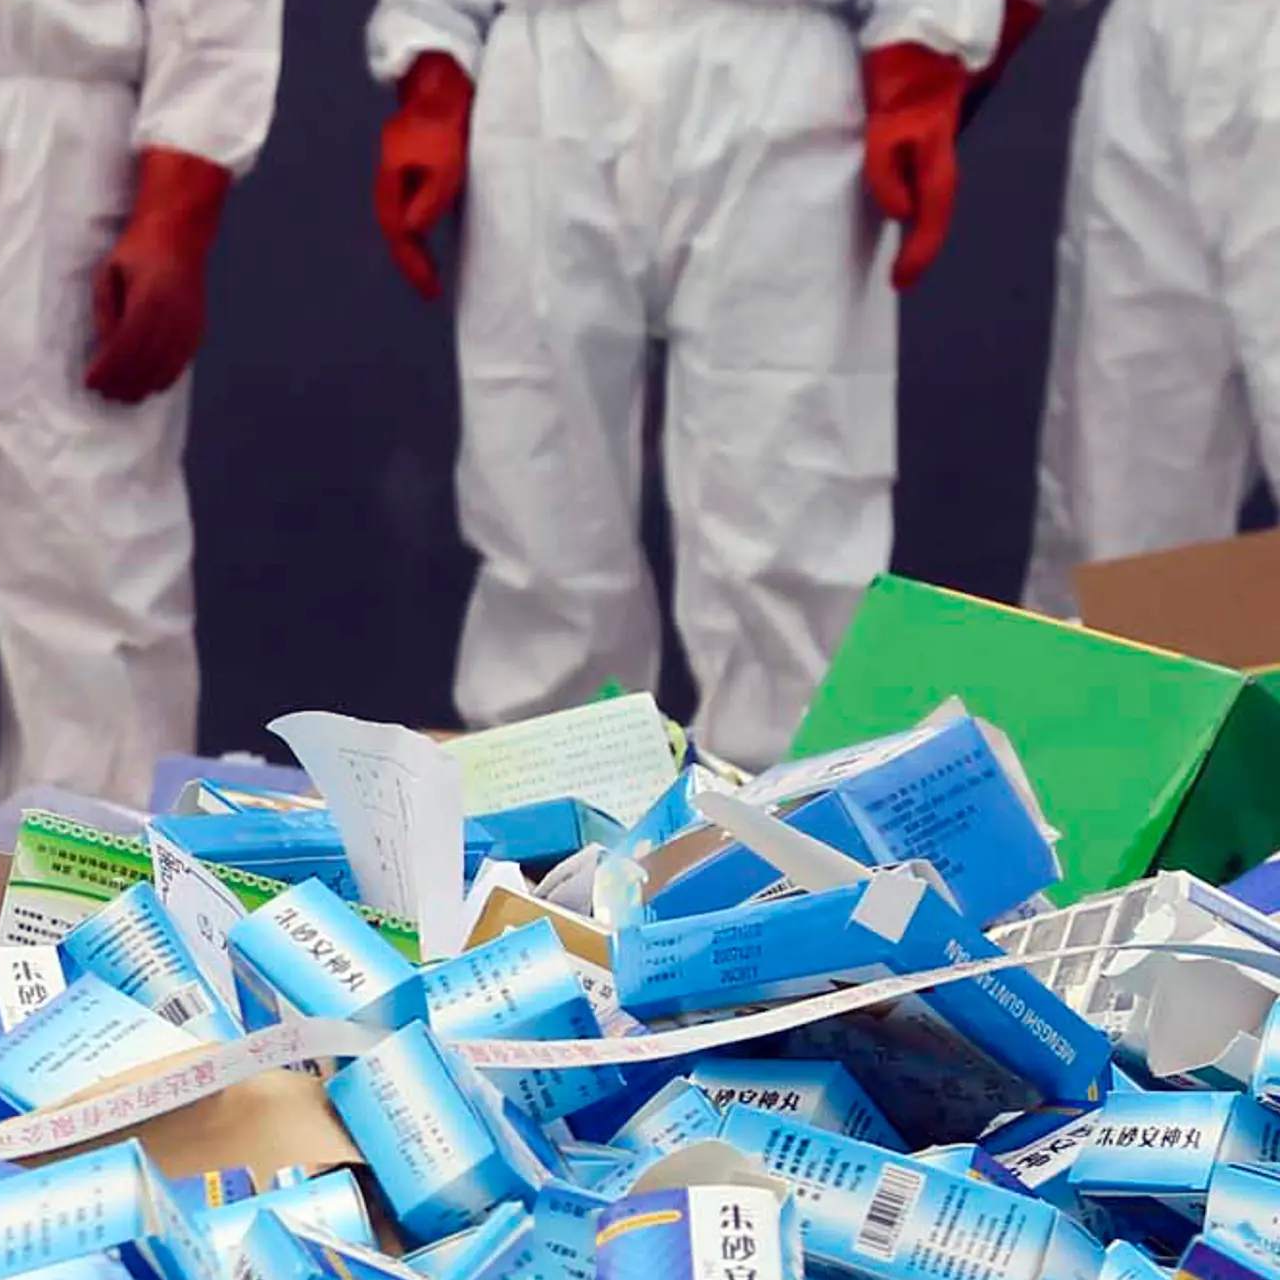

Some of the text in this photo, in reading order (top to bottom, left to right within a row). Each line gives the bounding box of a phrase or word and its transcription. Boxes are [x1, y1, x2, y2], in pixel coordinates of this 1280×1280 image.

[703, 1086, 802, 1112] 砂安神丸
[1096, 1124, 1203, 1150] 朱砂安神丸
